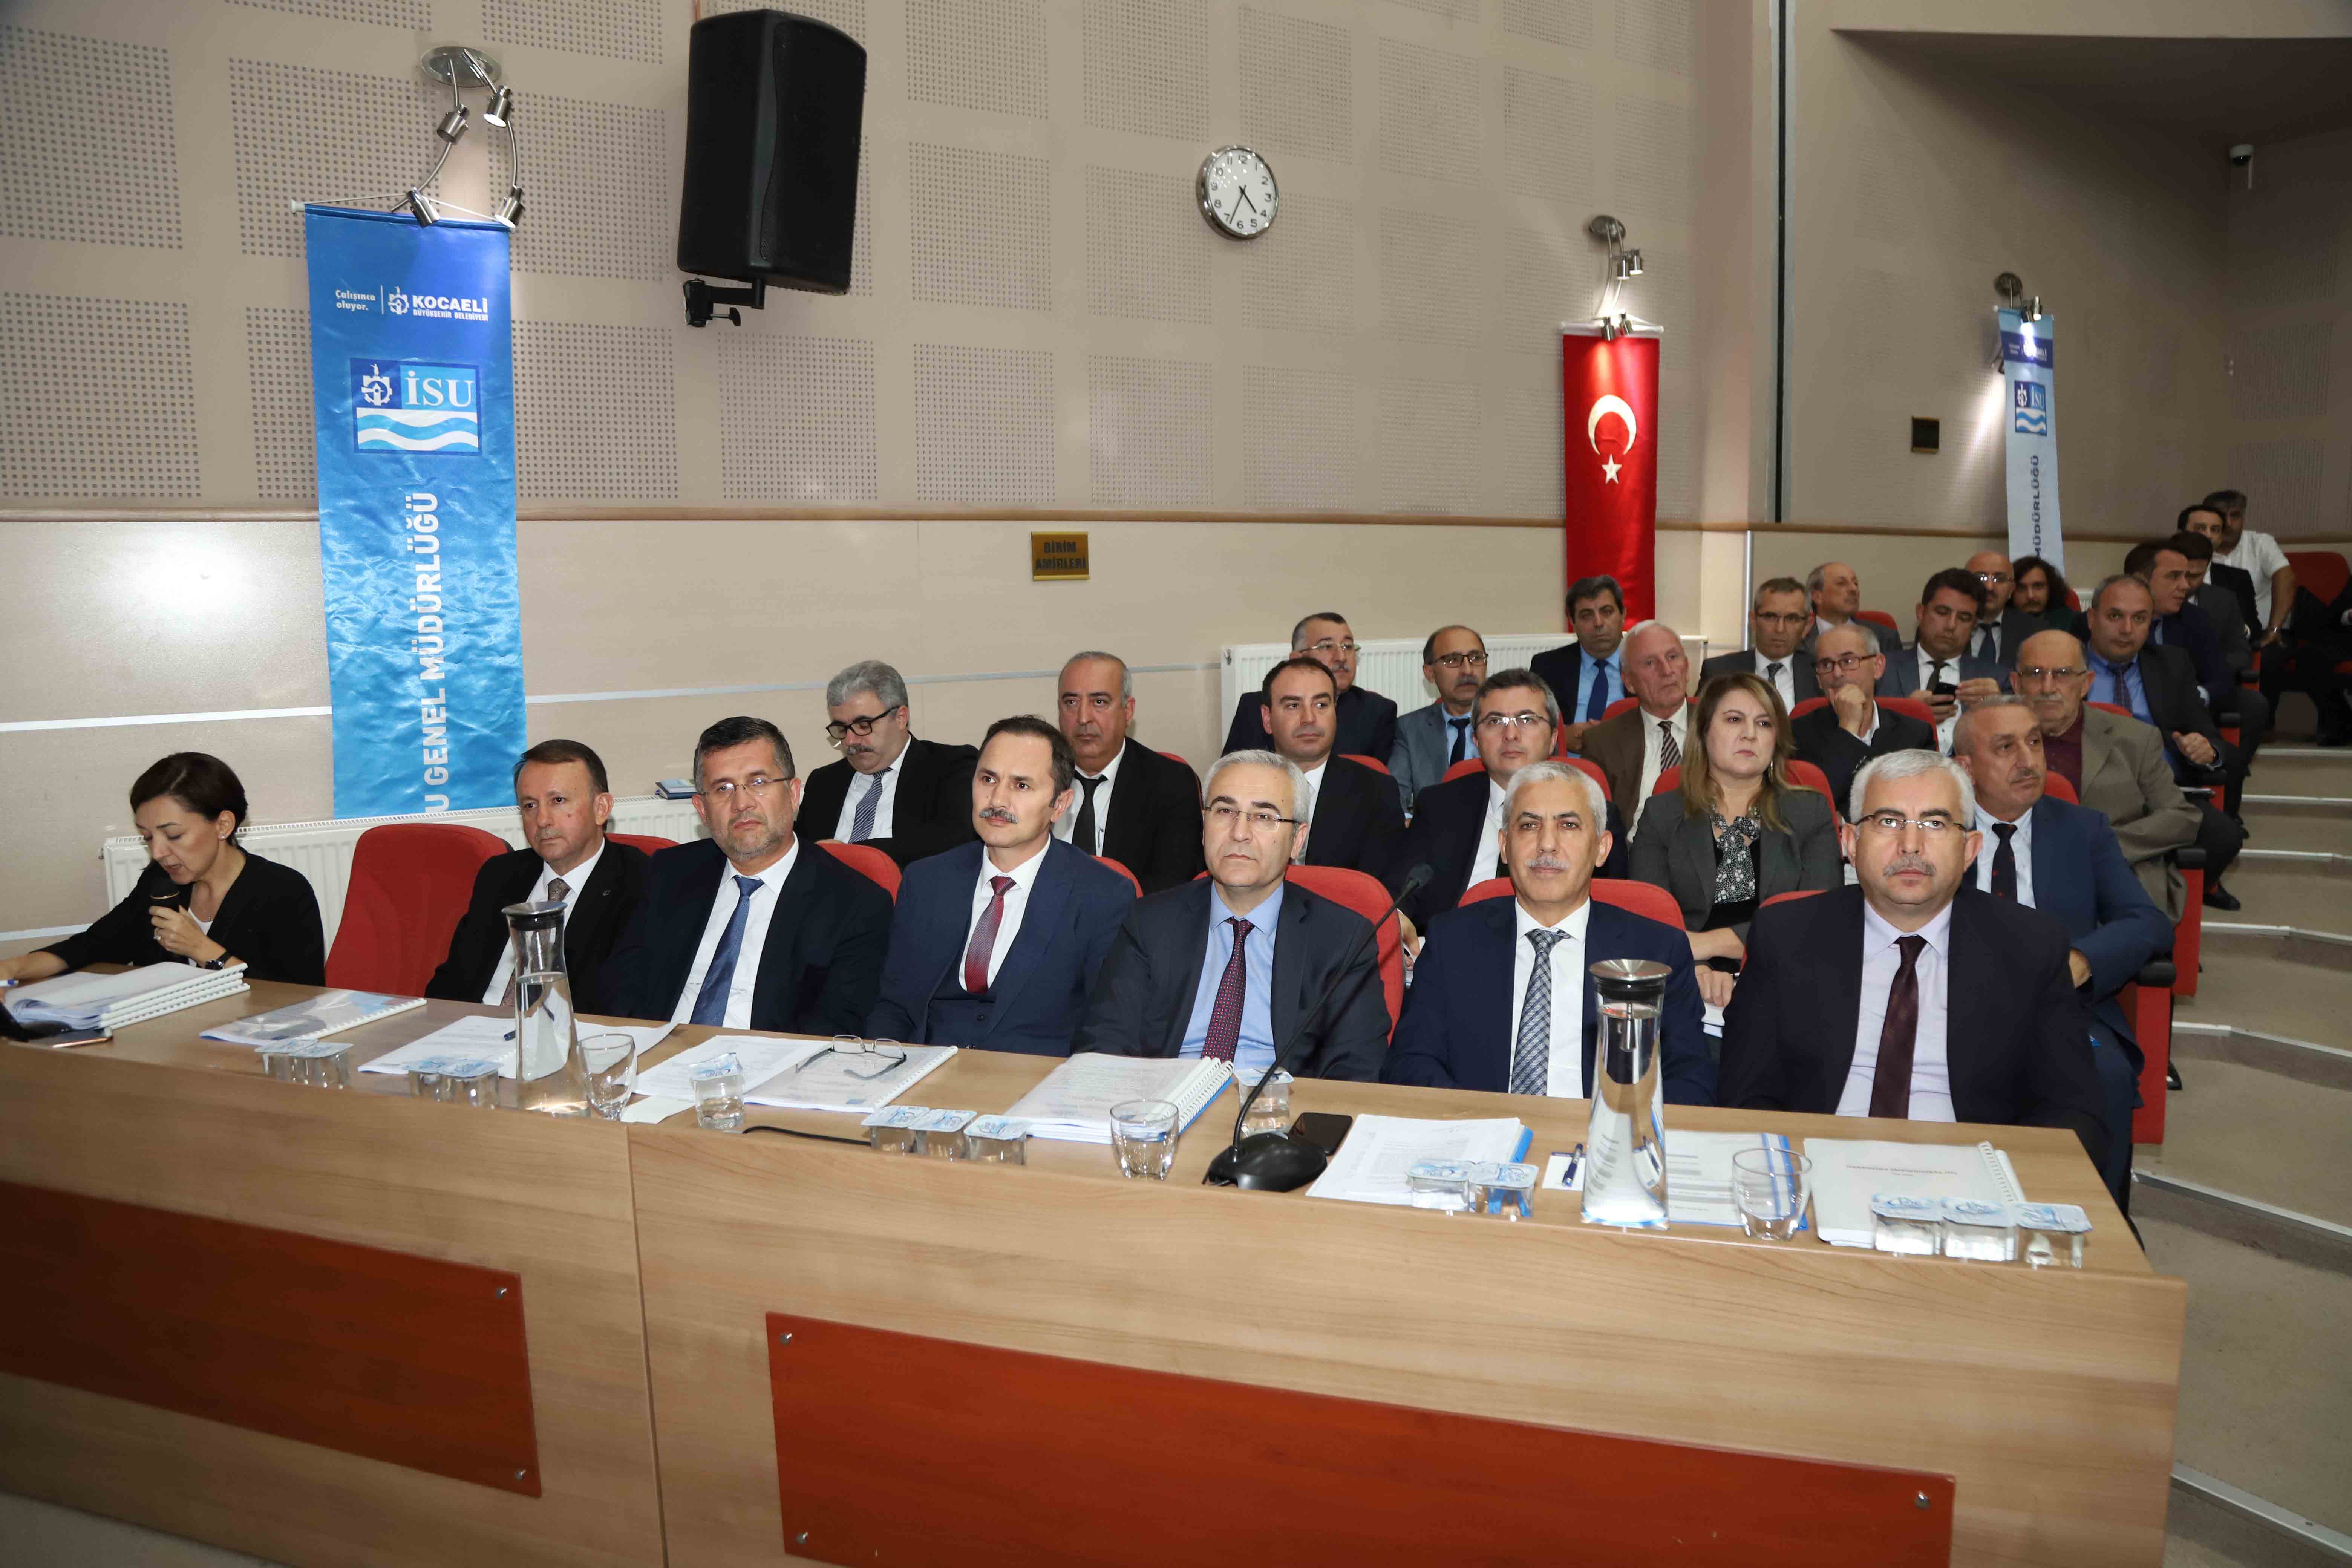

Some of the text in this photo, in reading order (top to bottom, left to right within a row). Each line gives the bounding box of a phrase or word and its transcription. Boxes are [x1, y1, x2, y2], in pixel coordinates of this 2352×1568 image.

[1227, 156, 1233, 165] 11
[1262, 176, 1269, 185] 2
[1265, 193, 1272, 202] 3
[1214, 199, 1222, 208] 8
[1260, 209, 1267, 217] 4
[1237, 220, 1243, 229] 6
[1251, 219, 1258, 228] 5
[335, 289, 376, 301] Çalışınca
[336, 302, 369, 312] oluyor.
[412, 294, 488, 313] KOCAELİ
[404, 370, 475, 407] İSU
[406, 493, 445, 680] MÜDÜRLÜĞÜ
[422, 688, 448, 786] GENEL
